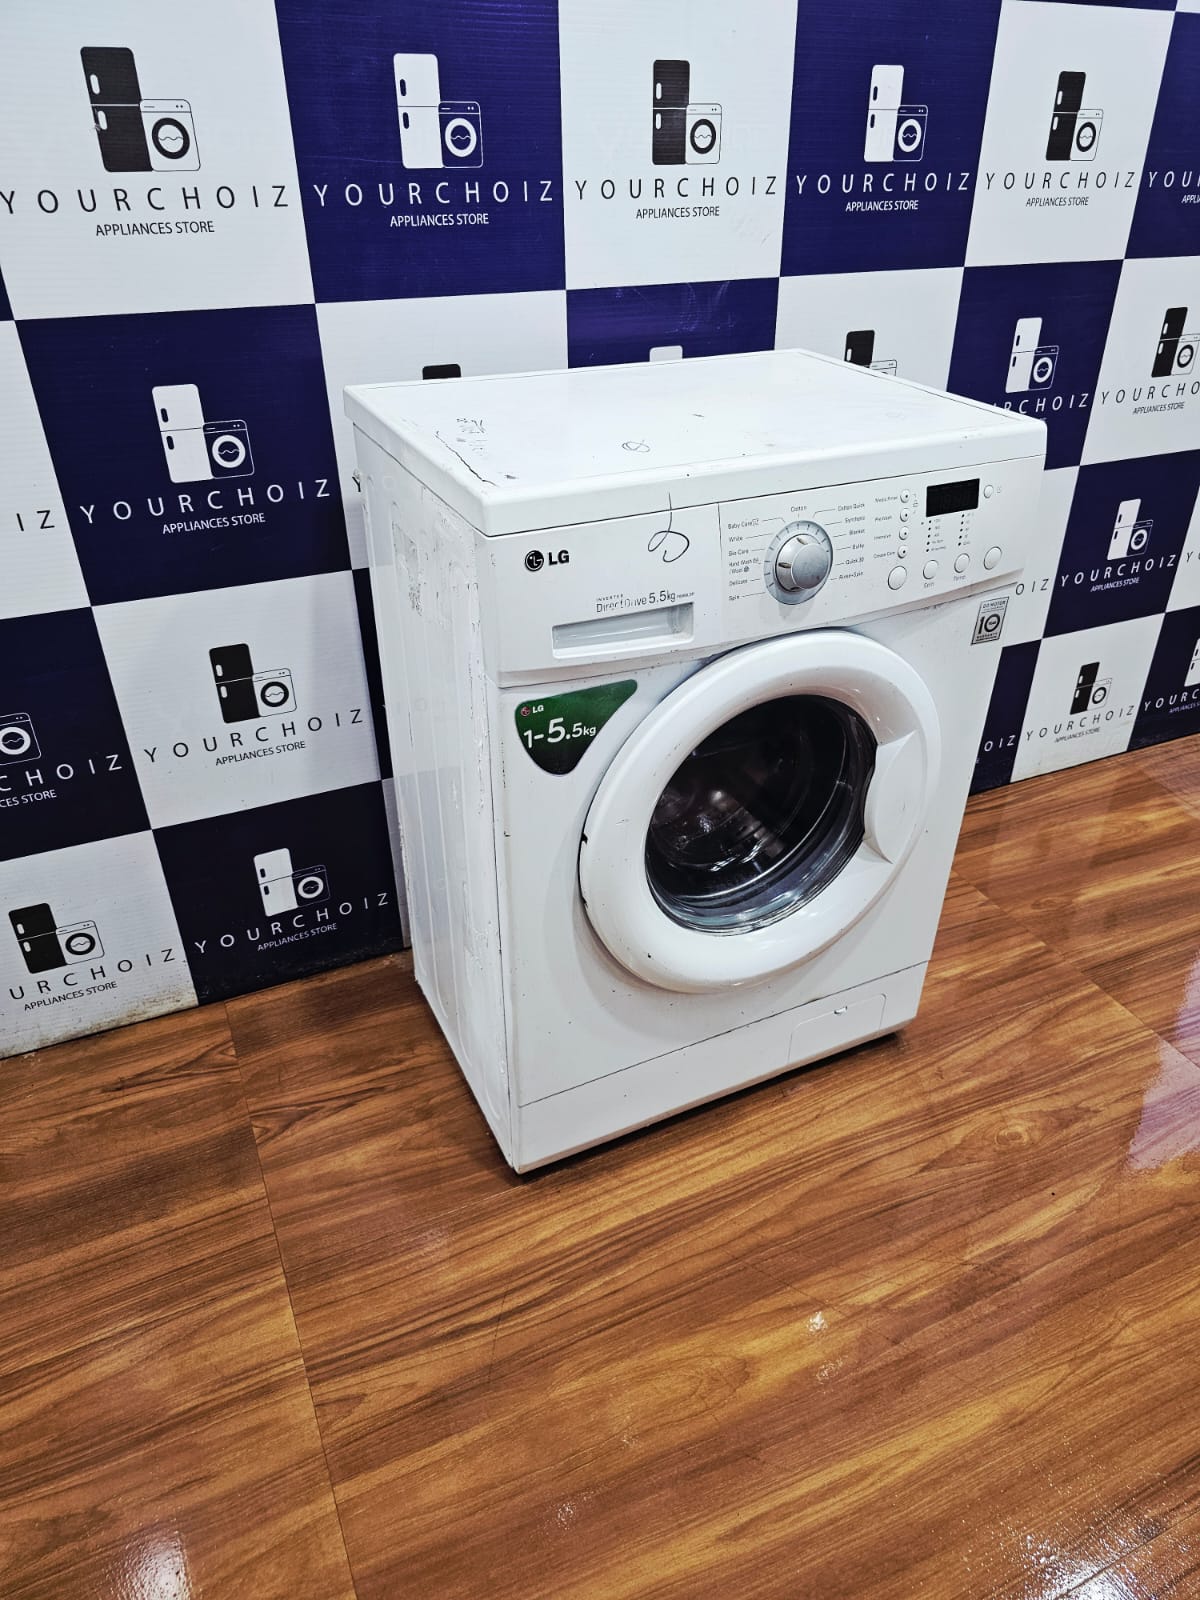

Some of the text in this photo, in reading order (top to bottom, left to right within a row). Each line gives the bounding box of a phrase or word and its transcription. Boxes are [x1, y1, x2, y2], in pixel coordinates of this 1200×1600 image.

[575, 177, 776, 200] YOURCHOIZ
[797, 173, 970, 194] YOURCHOIZ
[987, 172, 1135, 190] YOURCHOIZ
[1148, 171, 1200, 188] YOU
[314, 181, 553, 205] YOURCHOIZ
[1026, 196, 1089, 207] APPLIANCES STORE
[636, 206, 720, 219] APPLIANCES STORE
[846, 199, 918, 211] APPLIANCES STORE
[96, 220, 215, 236] APPLIANCES STORE
[390, 213, 490, 228] APPLIANCES STORE
[993, 394, 1089, 414] RCHOIZ
[1132, 401, 1185, 415] APPLIANCES STORE
[80, 479, 330, 524] YOURCHOIZ
[163, 512, 266, 534] APPLIANCES STORE
[548, 549, 570, 566] LG
[1061, 555, 1176, 587] YOURCHOIZ
[649, 589, 676, 604] 5.5kg
[532, 704, 544, 714] LG
[144, 709, 363, 763] YOURCHOIZ
[215, 740, 306, 766] APPLIANCES STORE
[21, 789, 57, 803] STORE
[194, 892, 389, 954] YOURCHOIZ
[256, 922, 338, 951] APPLIANCES STORE
[24, 980, 118, 1011] APPLIANCES STORE
